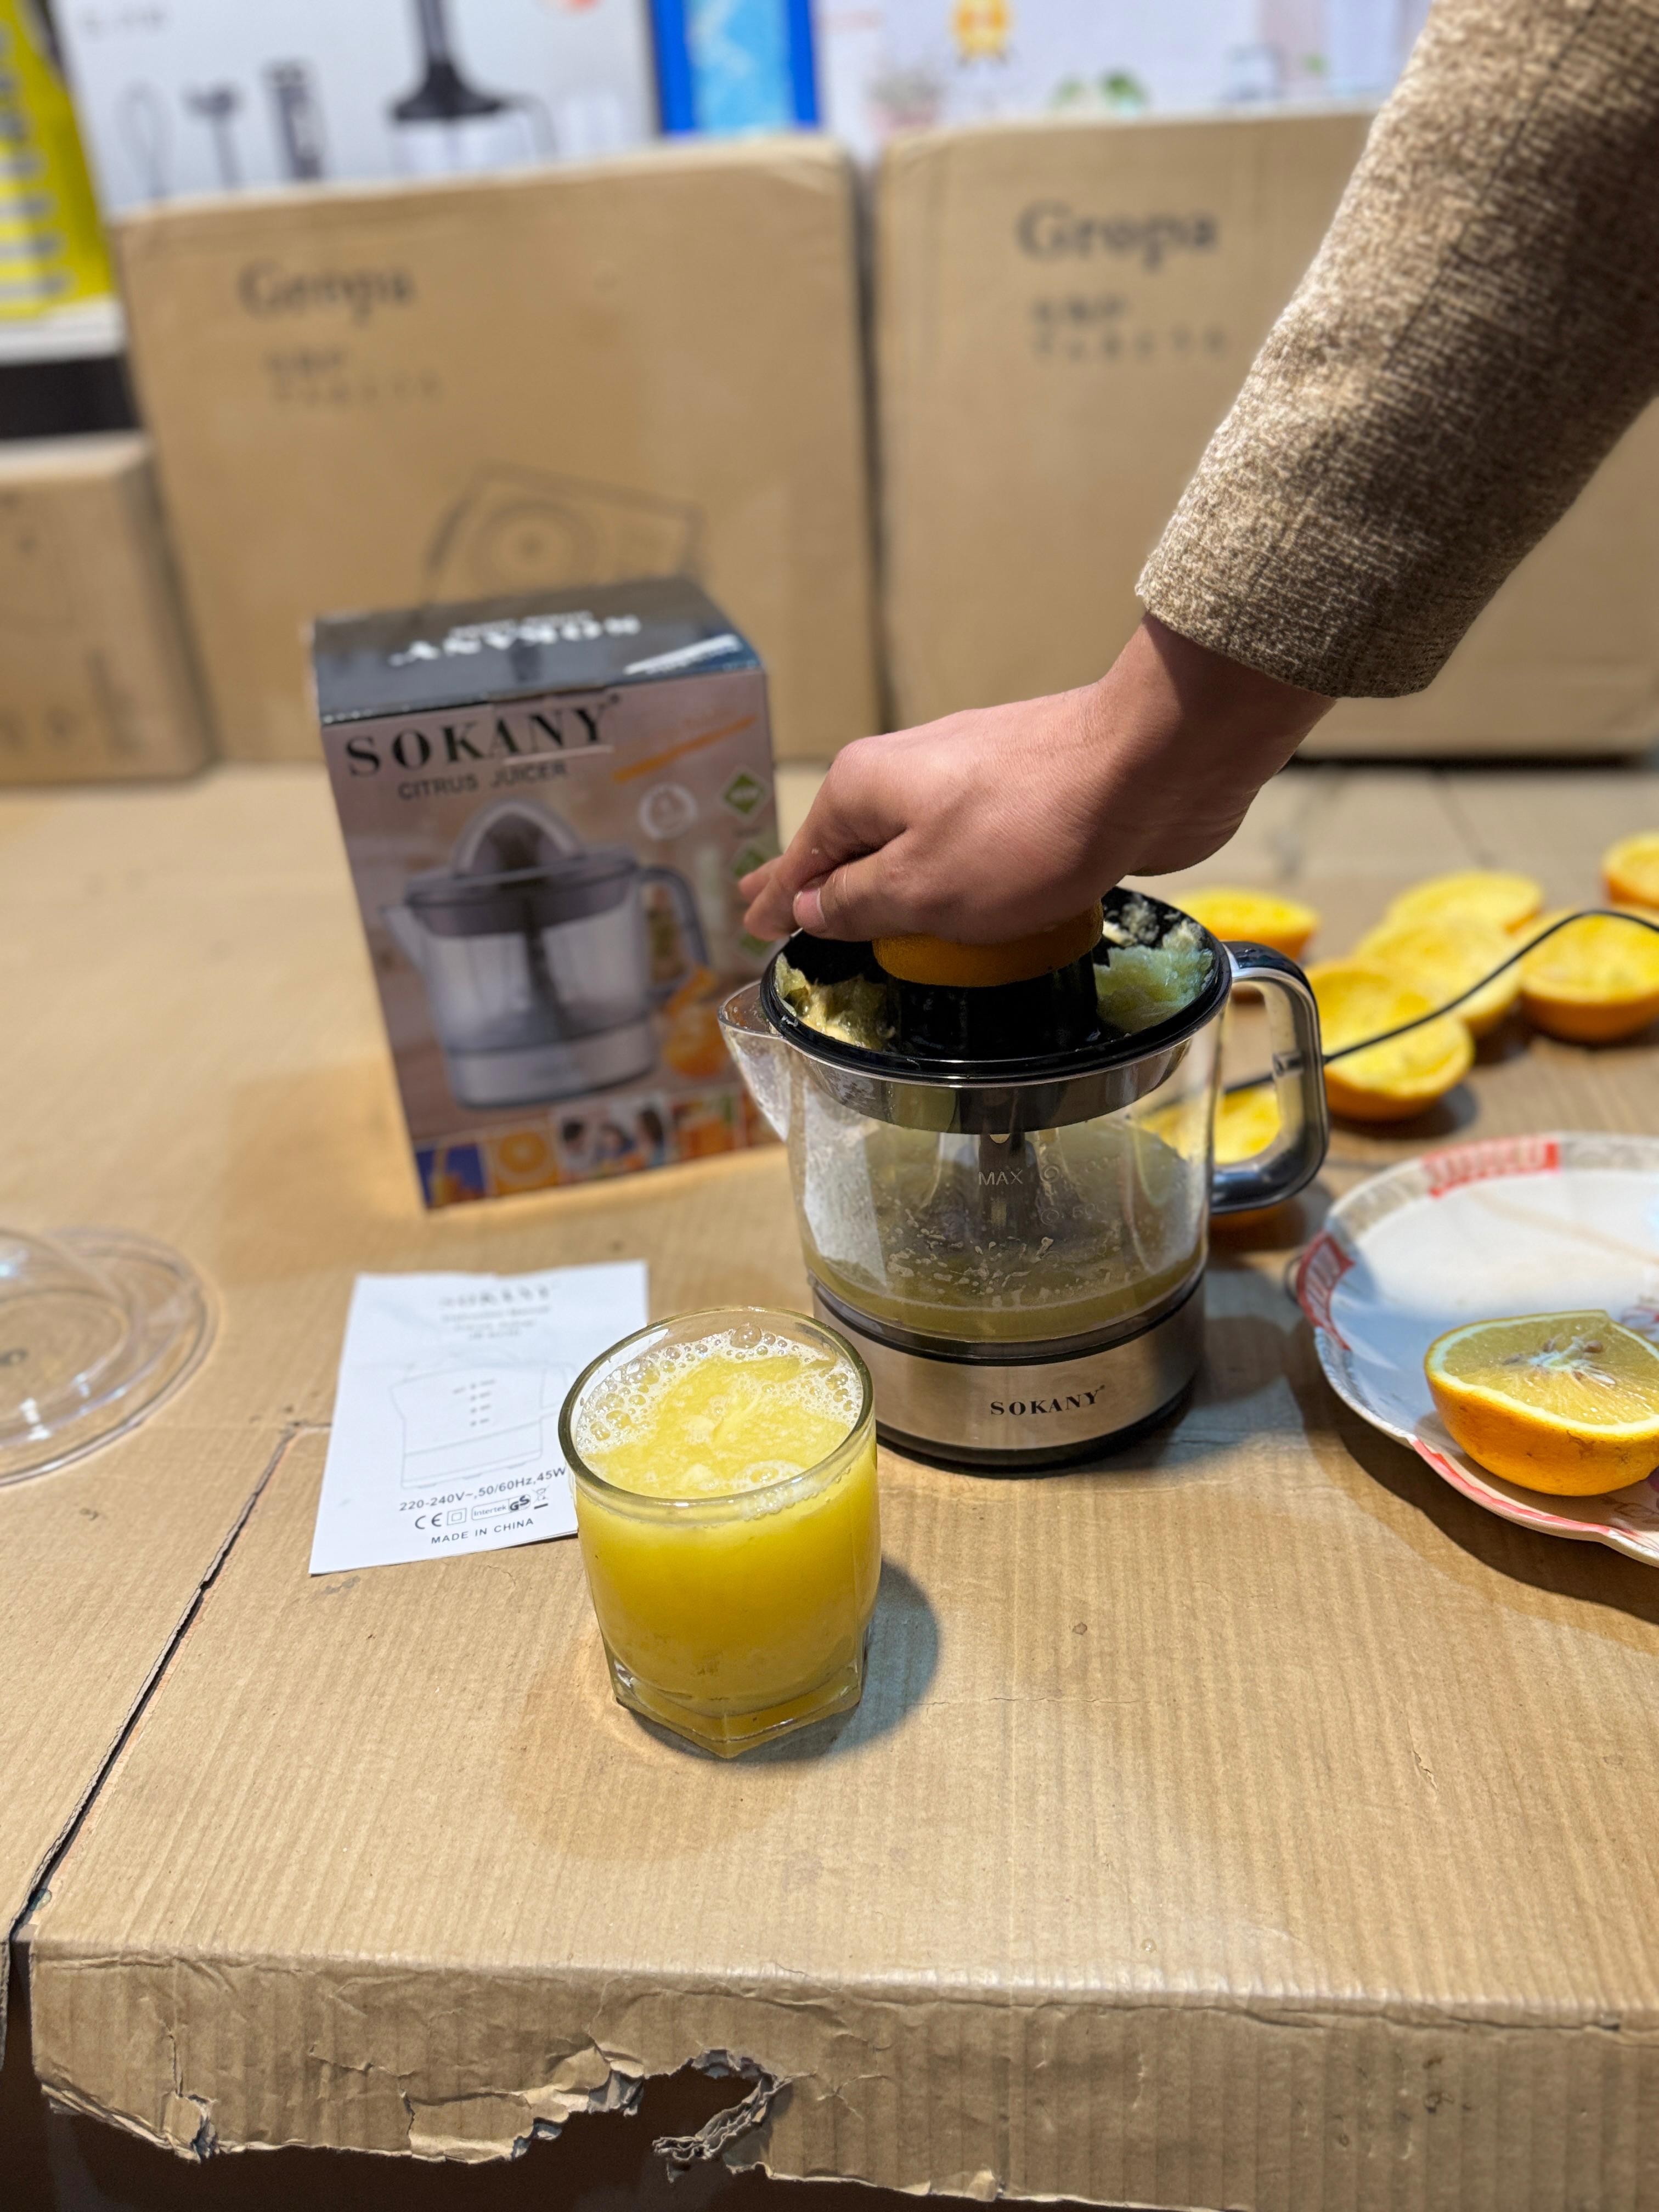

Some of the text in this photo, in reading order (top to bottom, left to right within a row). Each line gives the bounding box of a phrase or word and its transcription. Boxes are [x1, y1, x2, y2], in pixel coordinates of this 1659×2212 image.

[346, 708, 611, 776] SOKANY
[398, 763, 566, 799] CITRUS JUICER
[978, 1169, 1023, 1185] MAX
[990, 1390, 1098, 1415] SOKANY
[473, 1505, 507, 1517] Intertek
[509, 1495, 531, 1511] GS
[431, 1517, 534, 1544] MADE IN CHINA
